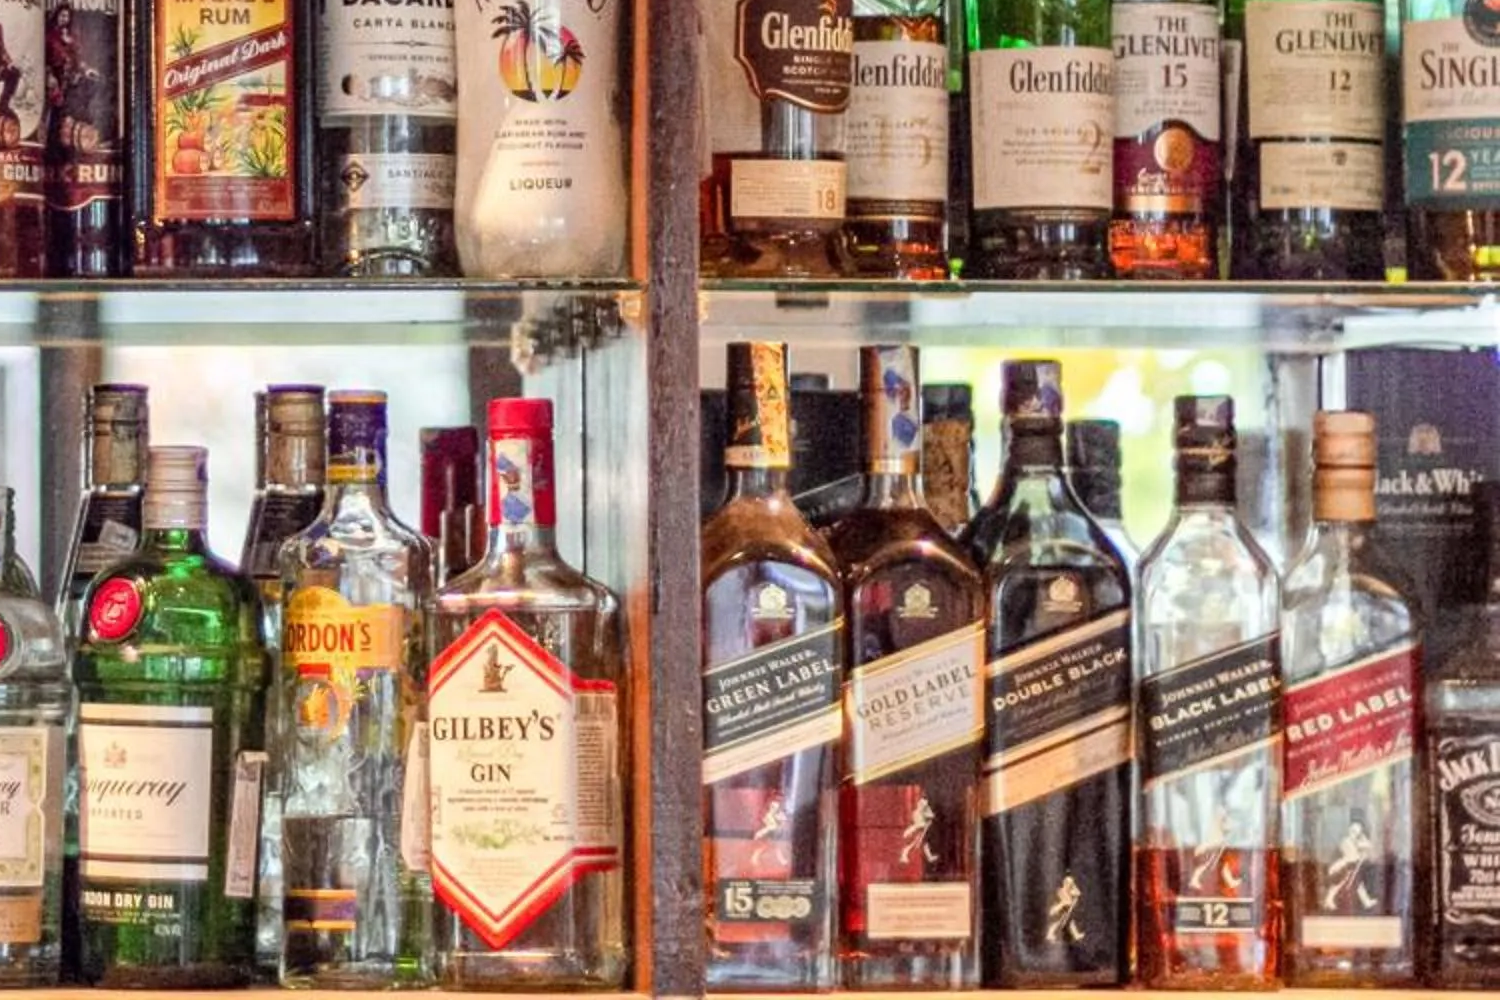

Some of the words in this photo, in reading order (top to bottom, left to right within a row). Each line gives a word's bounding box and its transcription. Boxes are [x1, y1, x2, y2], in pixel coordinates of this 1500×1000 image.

[200, 7, 250, 25] RUM
[353, 18, 403, 29] CARTA
[1154, 14, 1190, 32] THE
[1324, 11, 1357, 28] THE
[164, 46, 240, 88] Original
[240, 31, 287, 61] Dark
[1420, 49, 1500, 90] SINGL
[1162, 63, 1188, 89] 15
[1330, 69, 1351, 92] 12
[509, 177, 572, 191] LIQUEUR
[1428, 149, 1467, 192] 12
[815, 189, 836, 210] 18
[287, 621, 371, 652] ORDON'S
[857, 687, 909, 719] GOLD
[911, 664, 976, 699] LABEL
[992, 673, 1064, 711] DOUBLE
[1067, 647, 1127, 681] BLACK
[706, 680, 771, 714] GREEN
[868, 682, 970, 732] RESERVE
[1149, 696, 1217, 731] BLACK
[1219, 675, 1281, 706] LABEL
[433, 708, 555, 741] GILBEY'S
[1286, 713, 1334, 743] RED
[1337, 684, 1413, 723] LABEL
[470, 763, 512, 782] GIN
[1438, 750, 1489, 792] JACK
[114, 892, 144, 908] DRY
[147, 894, 175, 909] GIN
[725, 886, 752, 913] 15
[1202, 902, 1230, 926] 12
